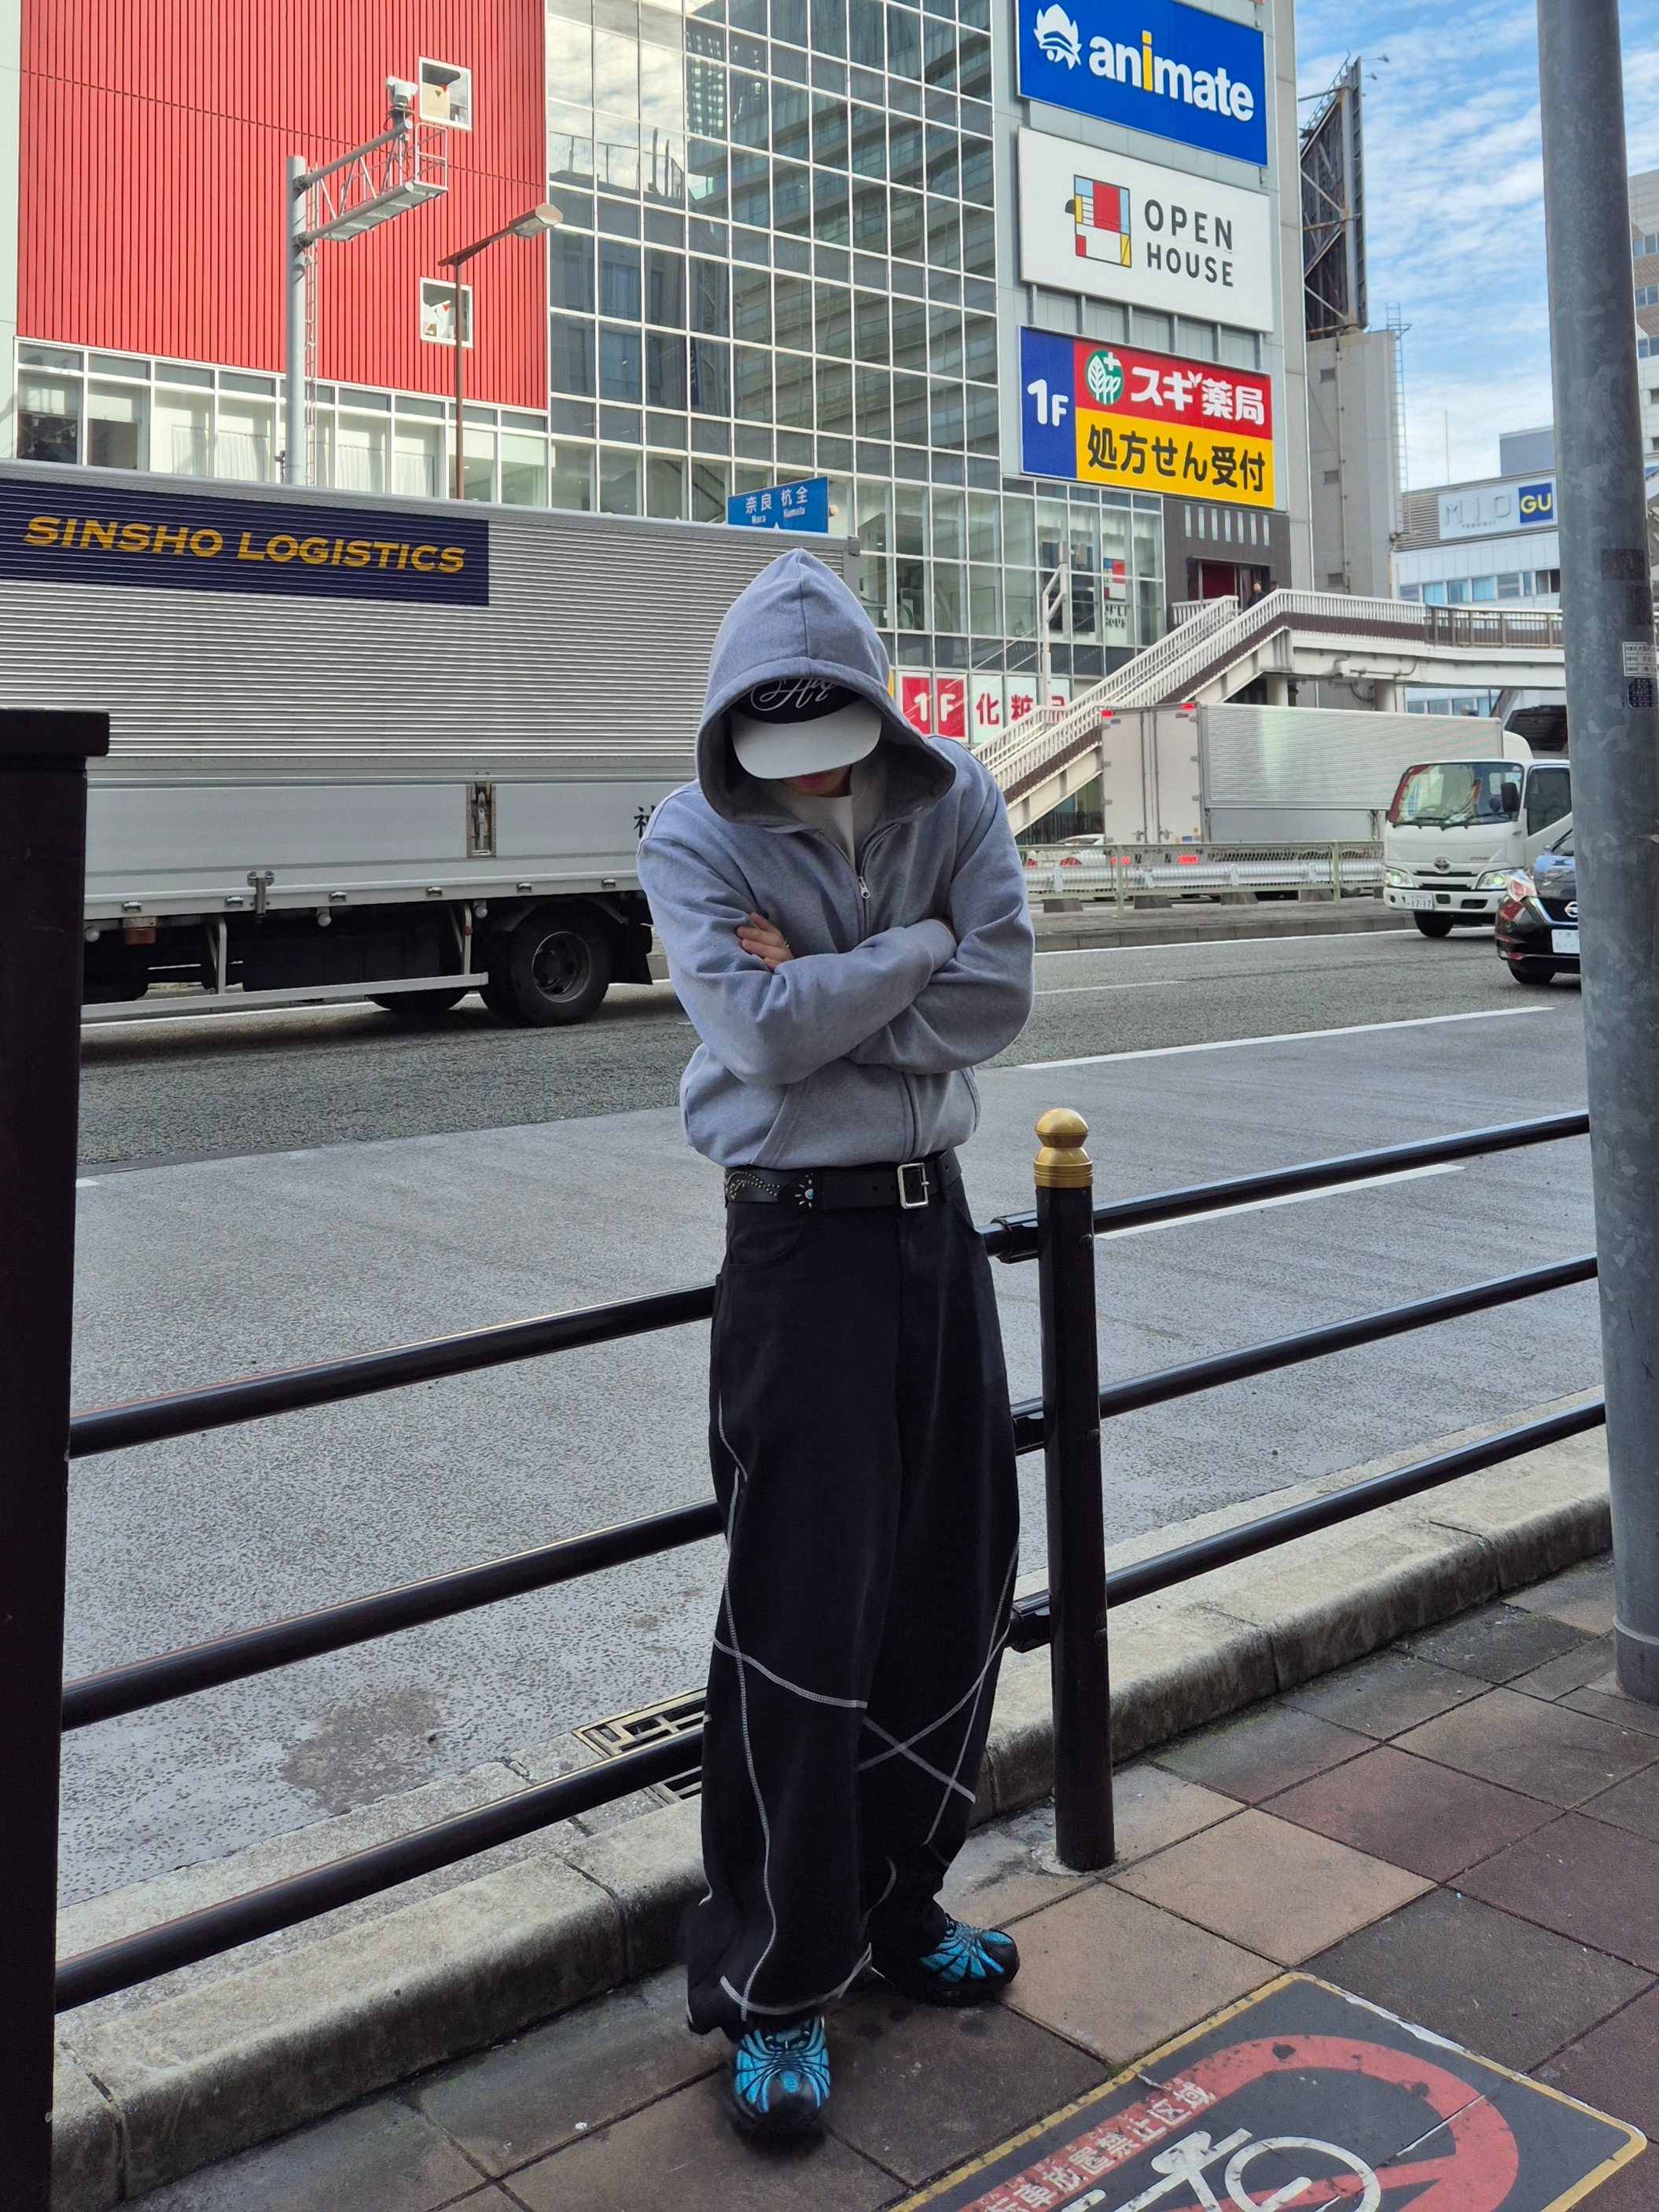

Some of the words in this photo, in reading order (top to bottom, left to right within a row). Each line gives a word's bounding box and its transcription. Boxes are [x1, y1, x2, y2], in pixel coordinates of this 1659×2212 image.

[1089, 30, 1254, 123] animate
[1144, 199, 1233, 252] OPEN
[1147, 241, 1234, 288] HOUSE
[1027, 378, 1069, 427] 1F
[1131, 366, 1265, 425] スギ薬局
[1087, 424, 1266, 493] 処方せん受付
[745, 493, 772, 514] 奈良
[781, 485, 808, 507] 杭全
[751, 514, 767, 524] Nara
[1444, 494, 1511, 526] MIO
[1520, 493, 1552, 514] GU
[24, 516, 224, 558] SINSHO
[237, 531, 466, 575] LOGISTICS
[914, 692, 956, 722] 1F
